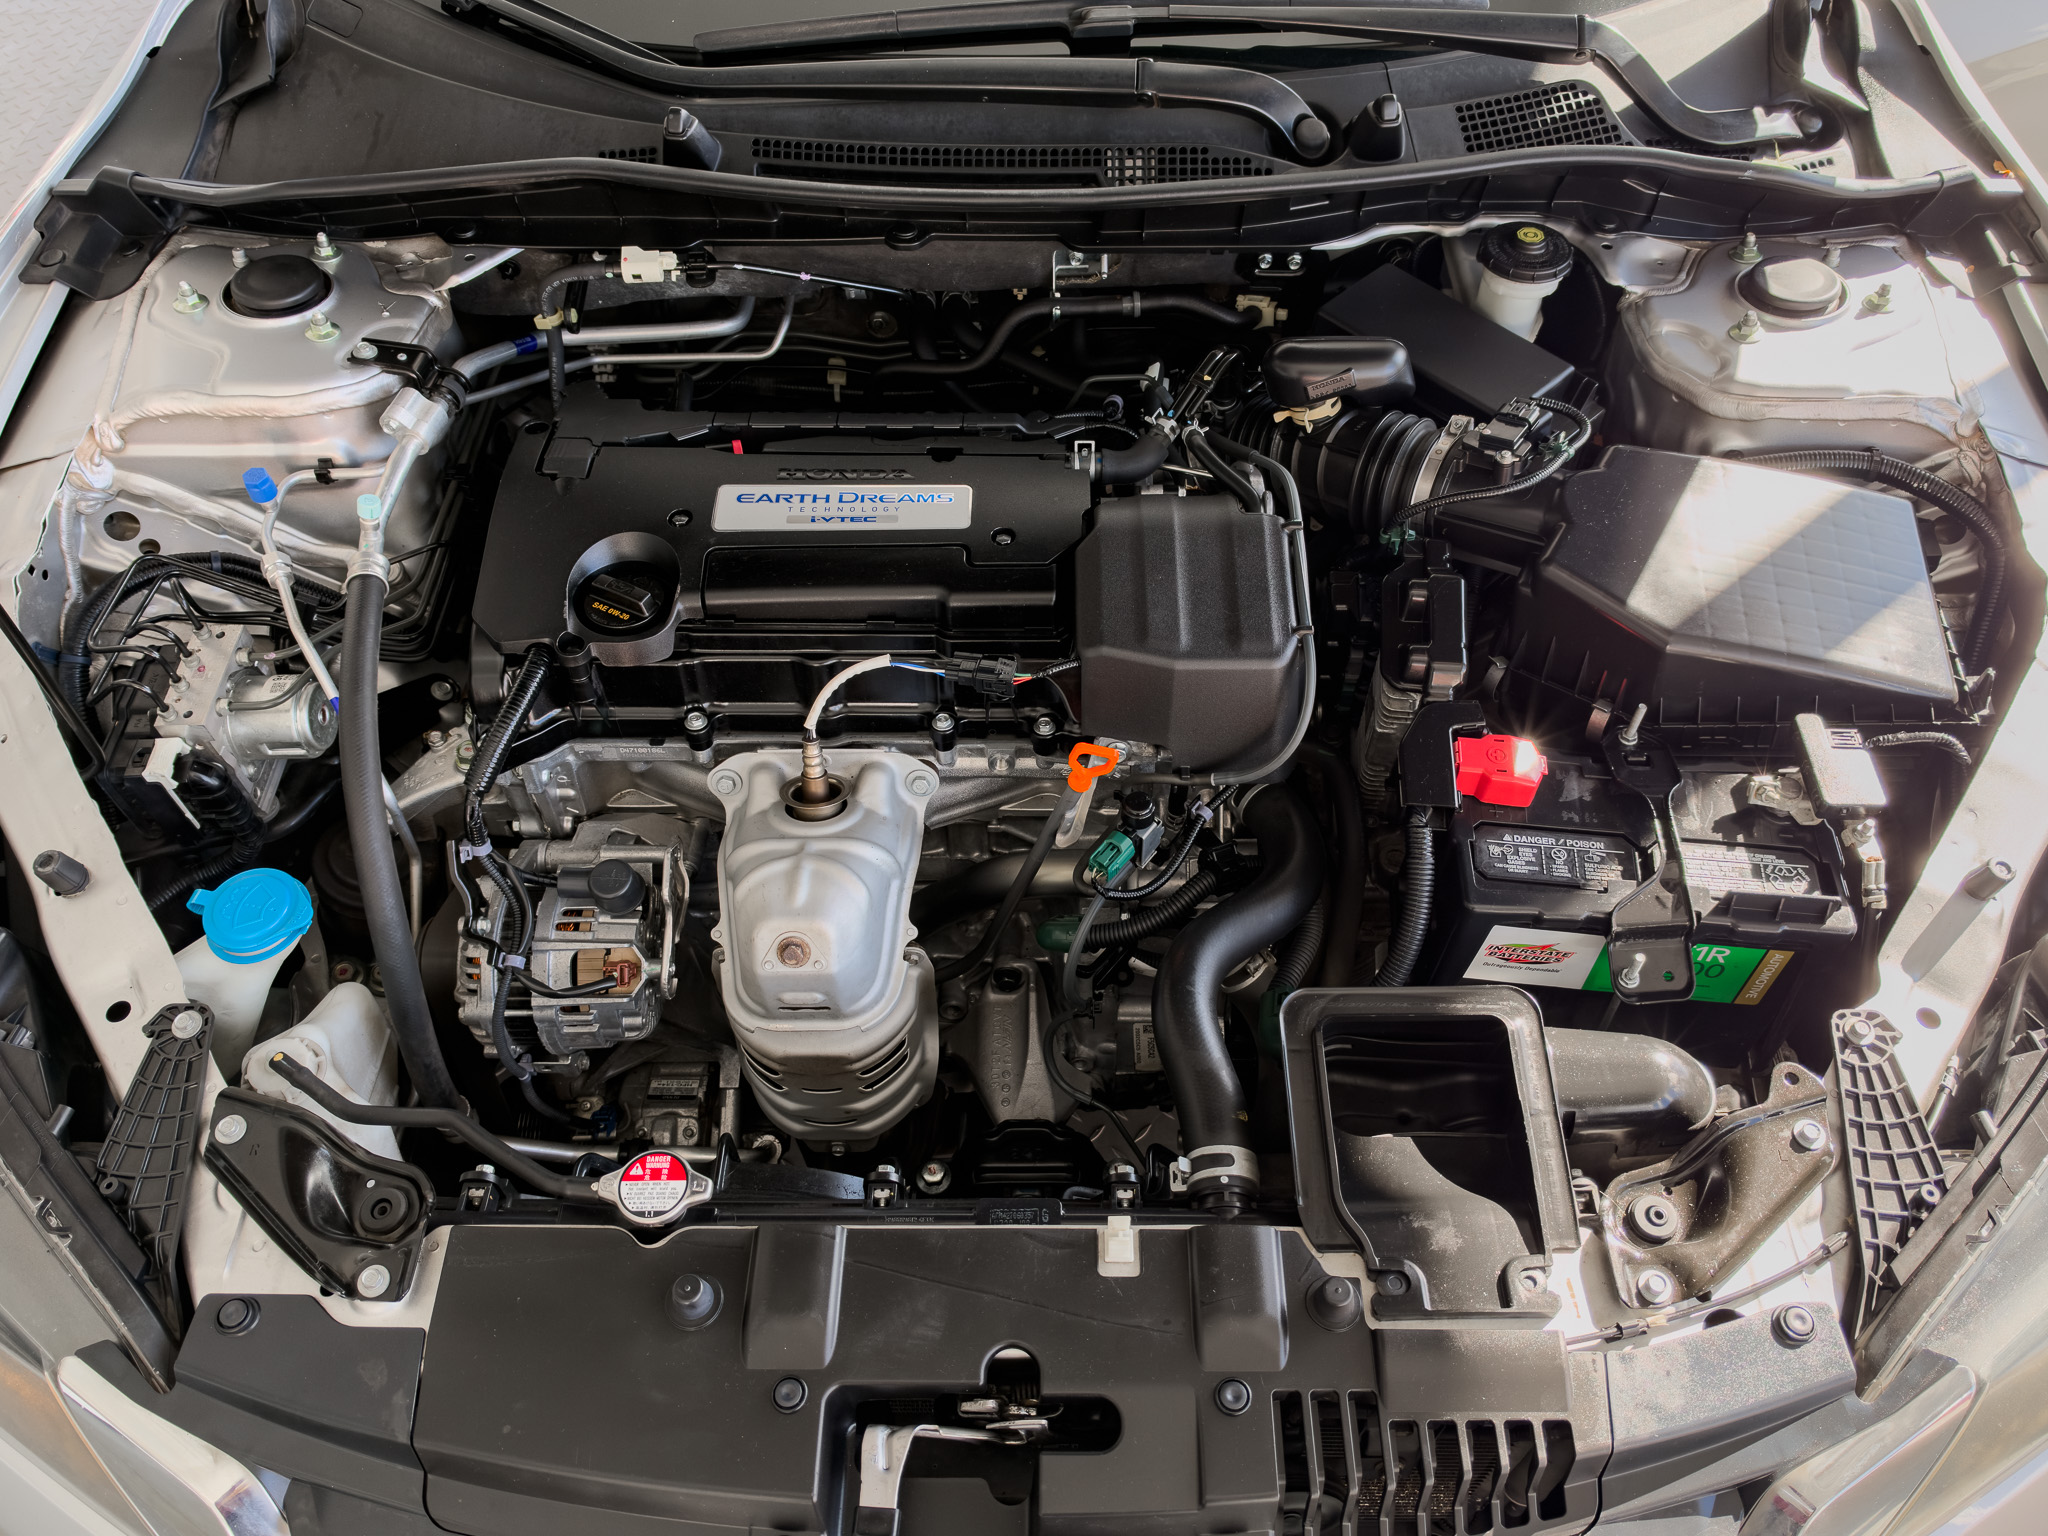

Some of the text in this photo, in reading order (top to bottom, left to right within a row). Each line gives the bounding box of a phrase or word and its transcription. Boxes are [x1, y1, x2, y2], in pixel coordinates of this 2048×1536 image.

[776, 468, 915, 481] HONDA
[736, 492, 954, 504] EARTH DREAMS
[810, 515, 877, 523] i-VTEC
[592, 601, 609, 612] SAE
[607, 608, 630, 621] 0W-20
[1514, 835, 1556, 845] DANGER
[1566, 840, 1604, 849] POISON
[1487, 951, 1564, 963] BATTERIES
[1488, 945, 1573, 958] INTERSTATE
[1692, 946, 1731, 963] 1R
[1482, 962, 1561, 974] Outrageously Dependable
[1745, 953, 1785, 999] AUTOMOTIVE
